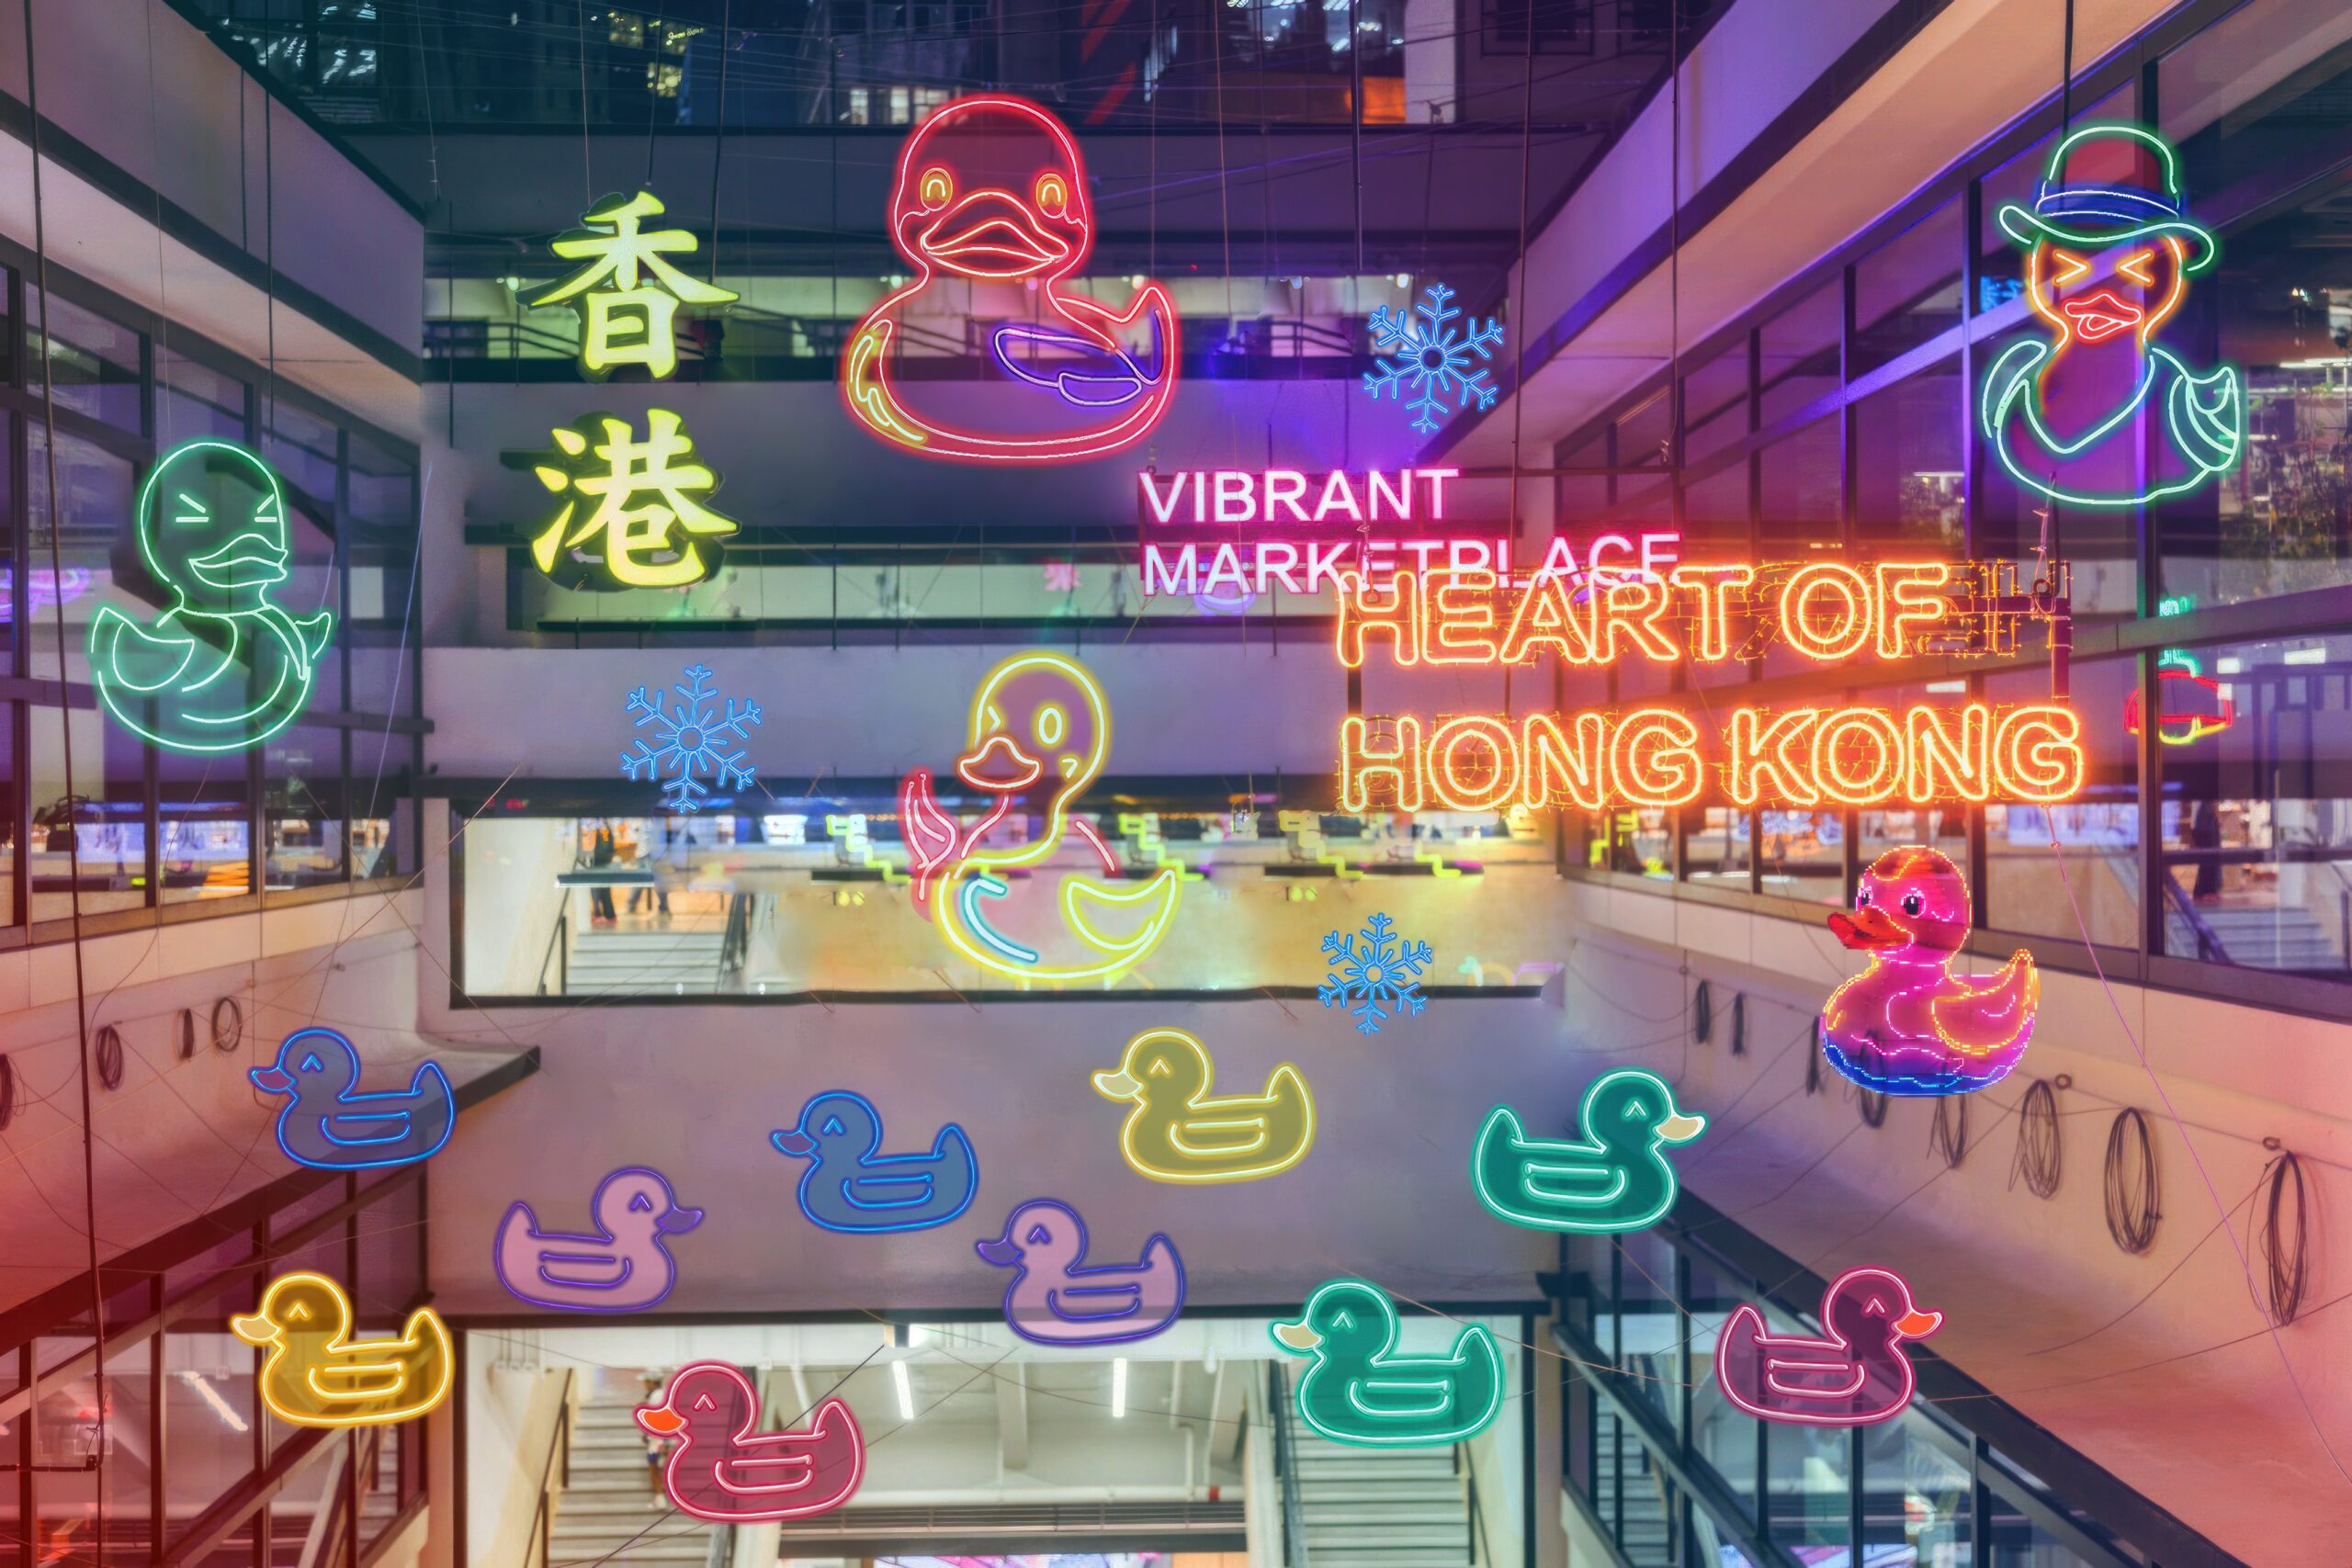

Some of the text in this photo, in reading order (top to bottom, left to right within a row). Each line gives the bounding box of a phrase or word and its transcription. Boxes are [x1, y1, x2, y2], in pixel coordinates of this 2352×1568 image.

[532, 191, 741, 587] 香港
[1138, 468, 1460, 523] VIBRANT
[1336, 562, 1950, 669] HEART OF
[1340, 704, 2084, 813] HONG KONG
